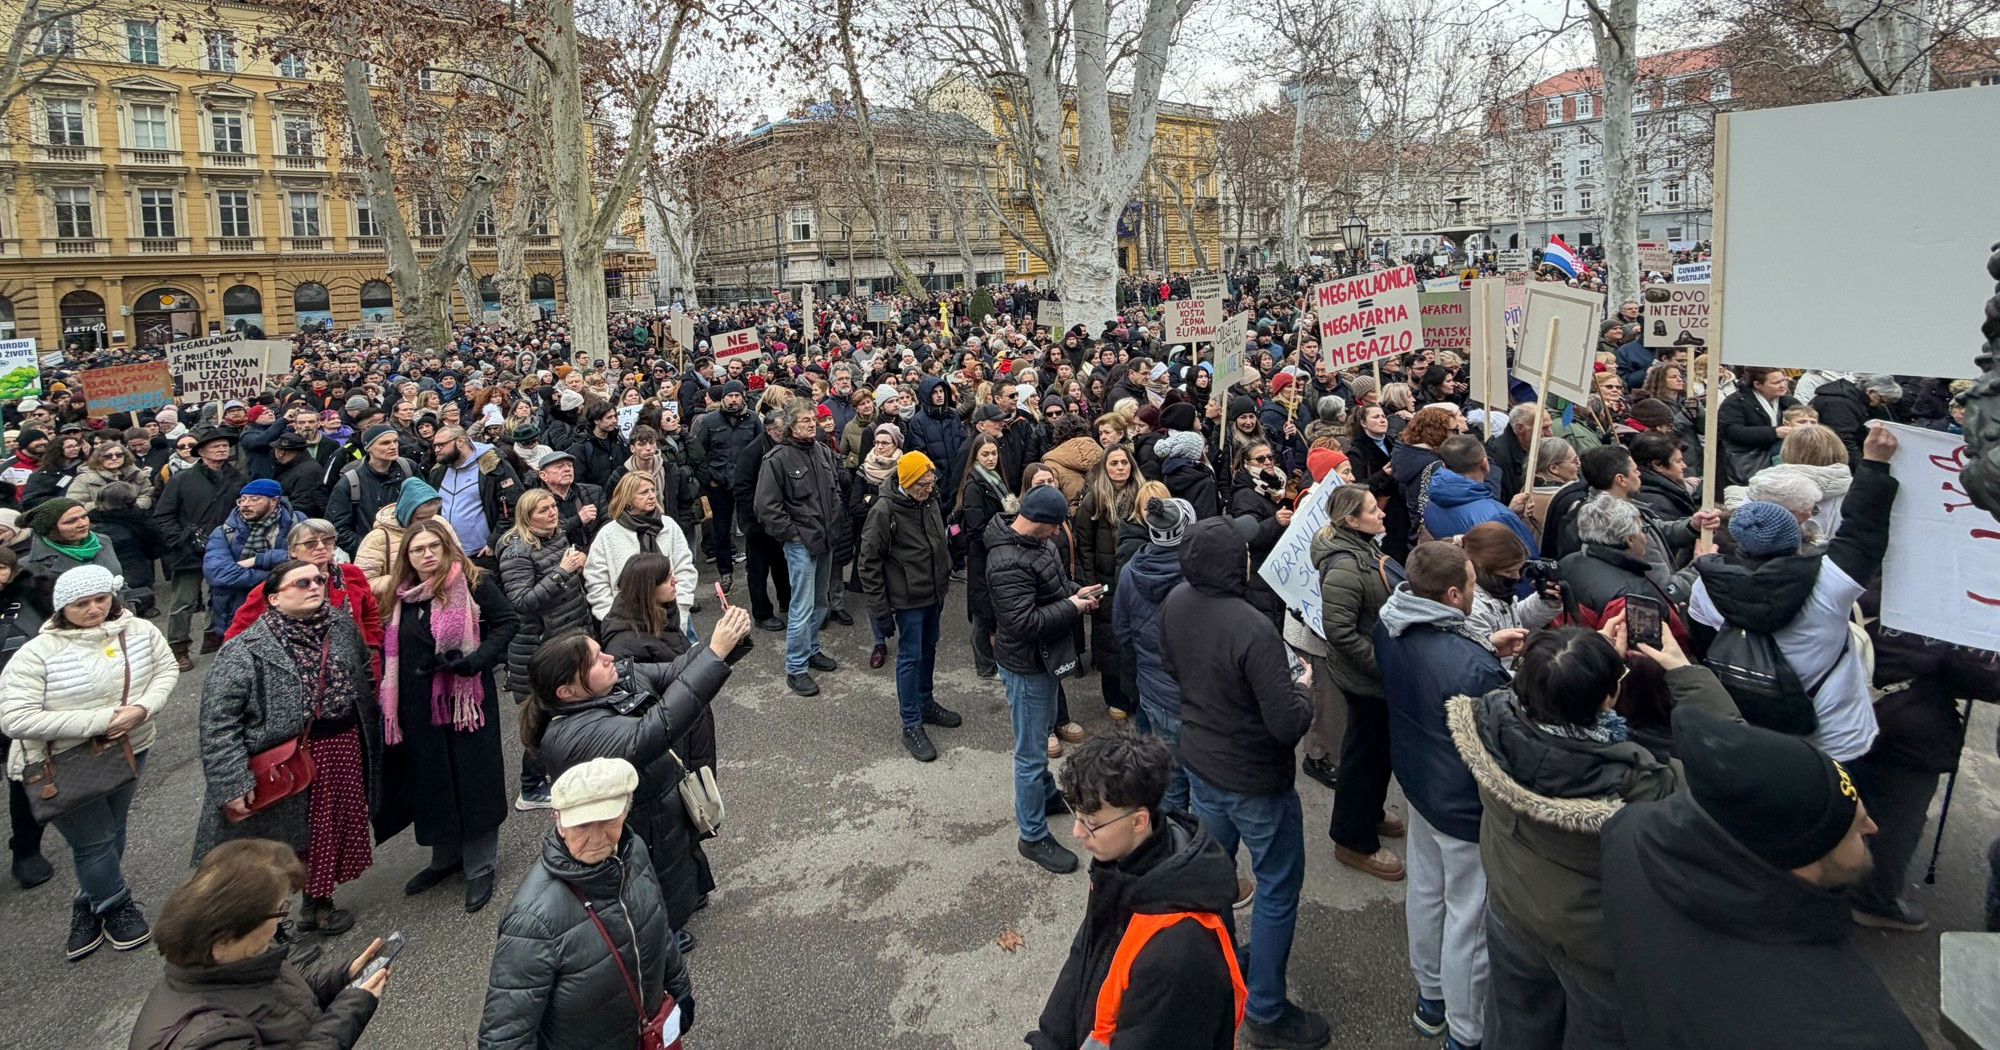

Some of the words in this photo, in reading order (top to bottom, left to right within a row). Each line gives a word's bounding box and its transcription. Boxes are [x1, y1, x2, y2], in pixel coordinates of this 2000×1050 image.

[1678, 265, 1705, 274] ČUVAMO
[1318, 266, 1417, 308] MEGAKLAONICA
[1672, 290, 1705, 302] OVO
[1176, 300, 1204, 310] KOLIKO
[1180, 309, 1205, 318] KOŠTA
[1180, 318, 1205, 326] JEDNA
[1322, 304, 1408, 338] MEGAFARMA
[1679, 318, 1709, 328] UZG
[1175, 326, 1216, 337] ŽUPANIJA
[170, 334, 242, 353] MEGAKLAONICA
[727, 333, 748, 347] NE
[1332, 330, 1412, 367] MEGAZLO
[172, 354, 182, 365] JE
[184, 358, 258, 372] INTENZIVAN
[200, 369, 248, 380] UZGOJ
[185, 377, 258, 392] INTENZIVNA
[200, 388, 256, 401] PATNJA
